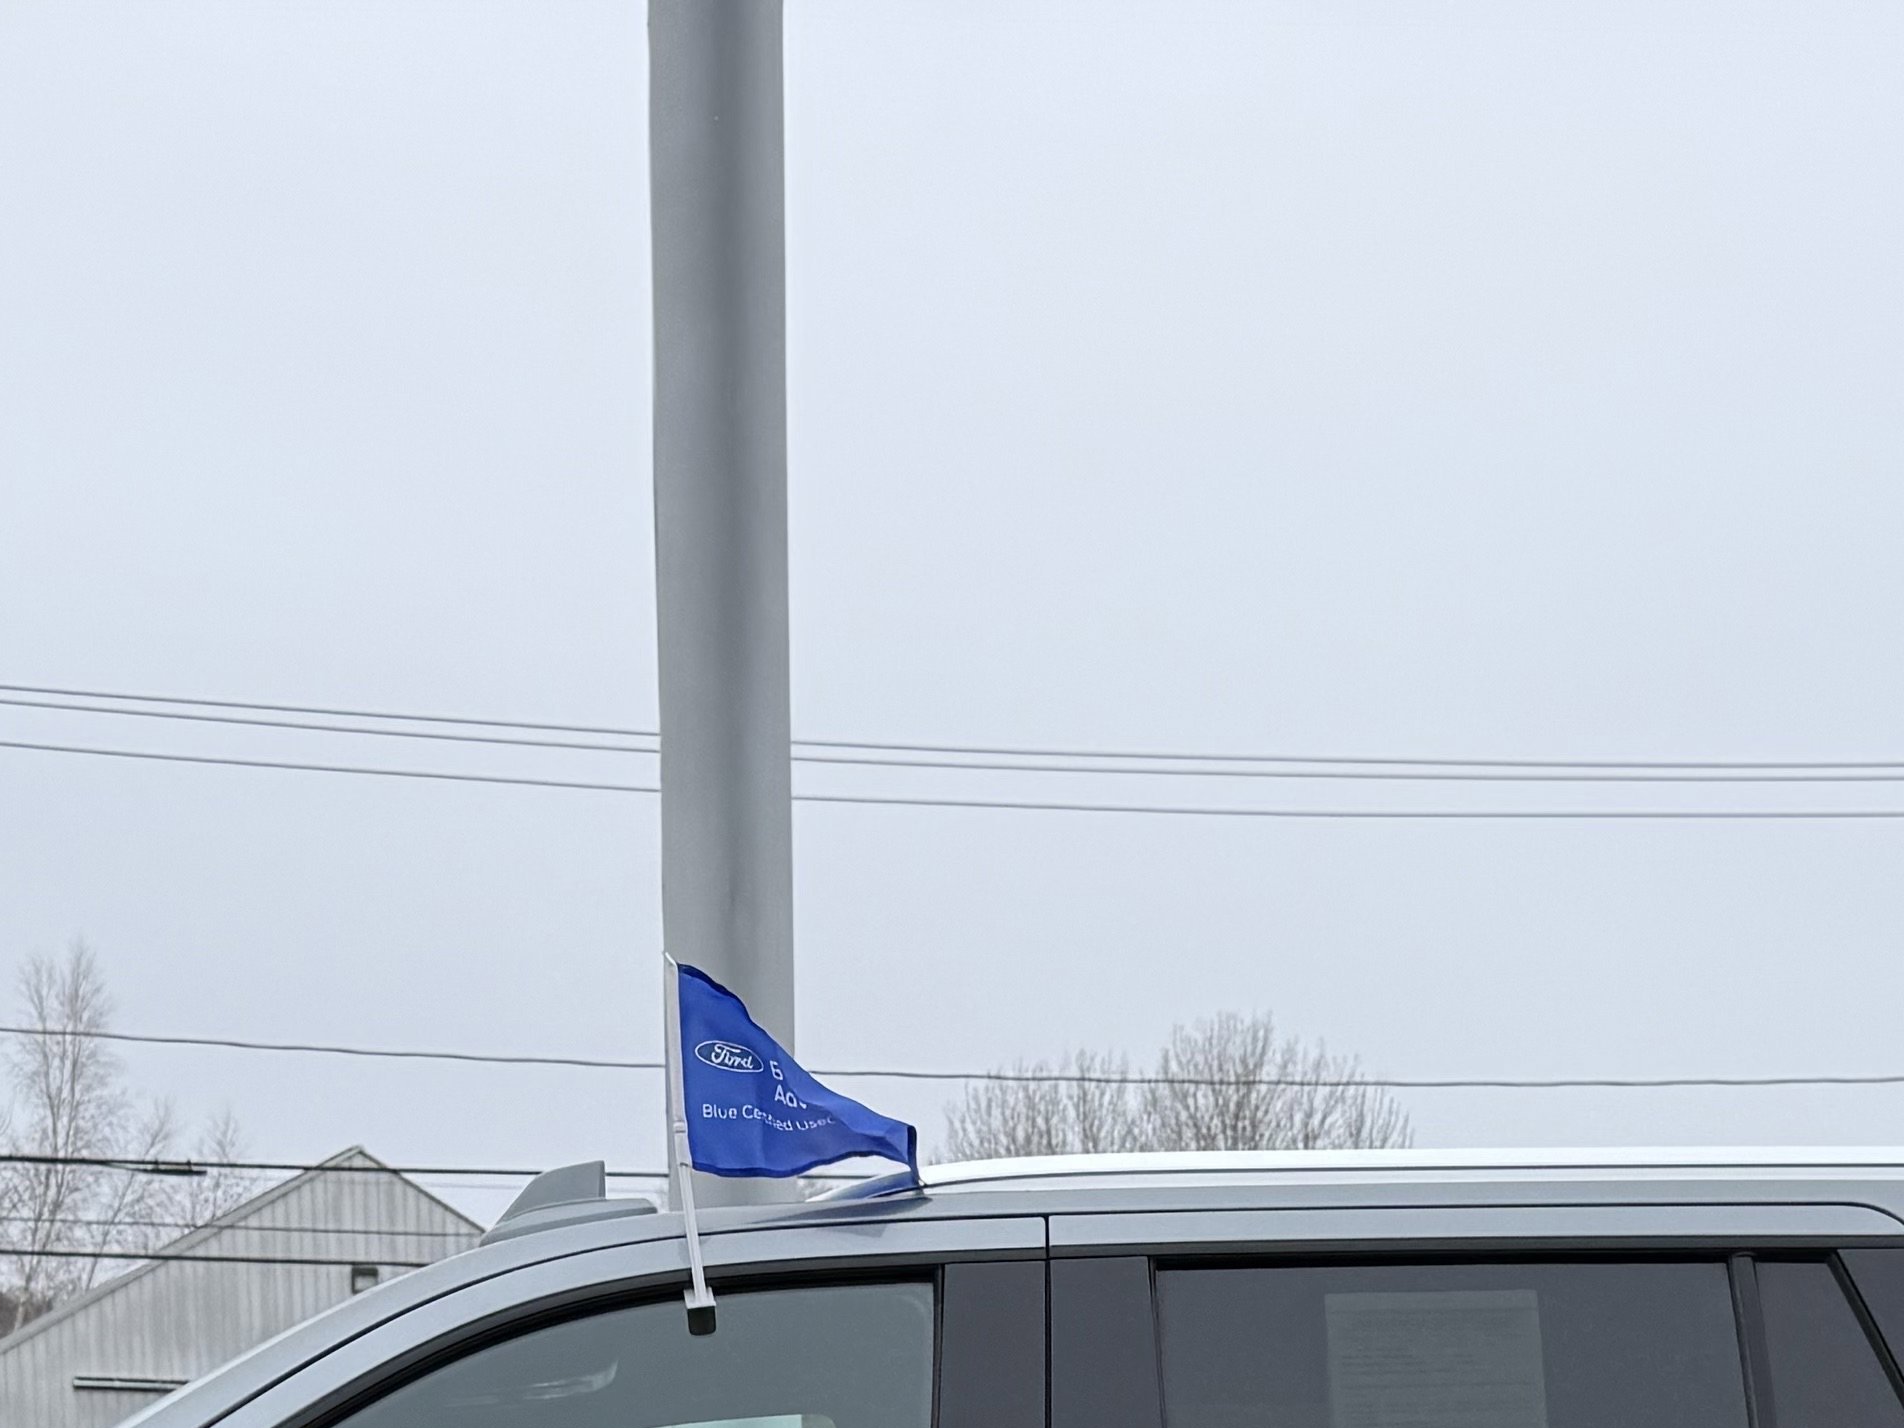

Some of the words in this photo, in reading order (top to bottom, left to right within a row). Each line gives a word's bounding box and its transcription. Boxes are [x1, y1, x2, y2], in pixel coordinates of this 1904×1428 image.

[711, 1043, 754, 1069] Ford
[702, 1103, 738, 1120] Blue
[742, 1104, 793, 1132] Ceried
